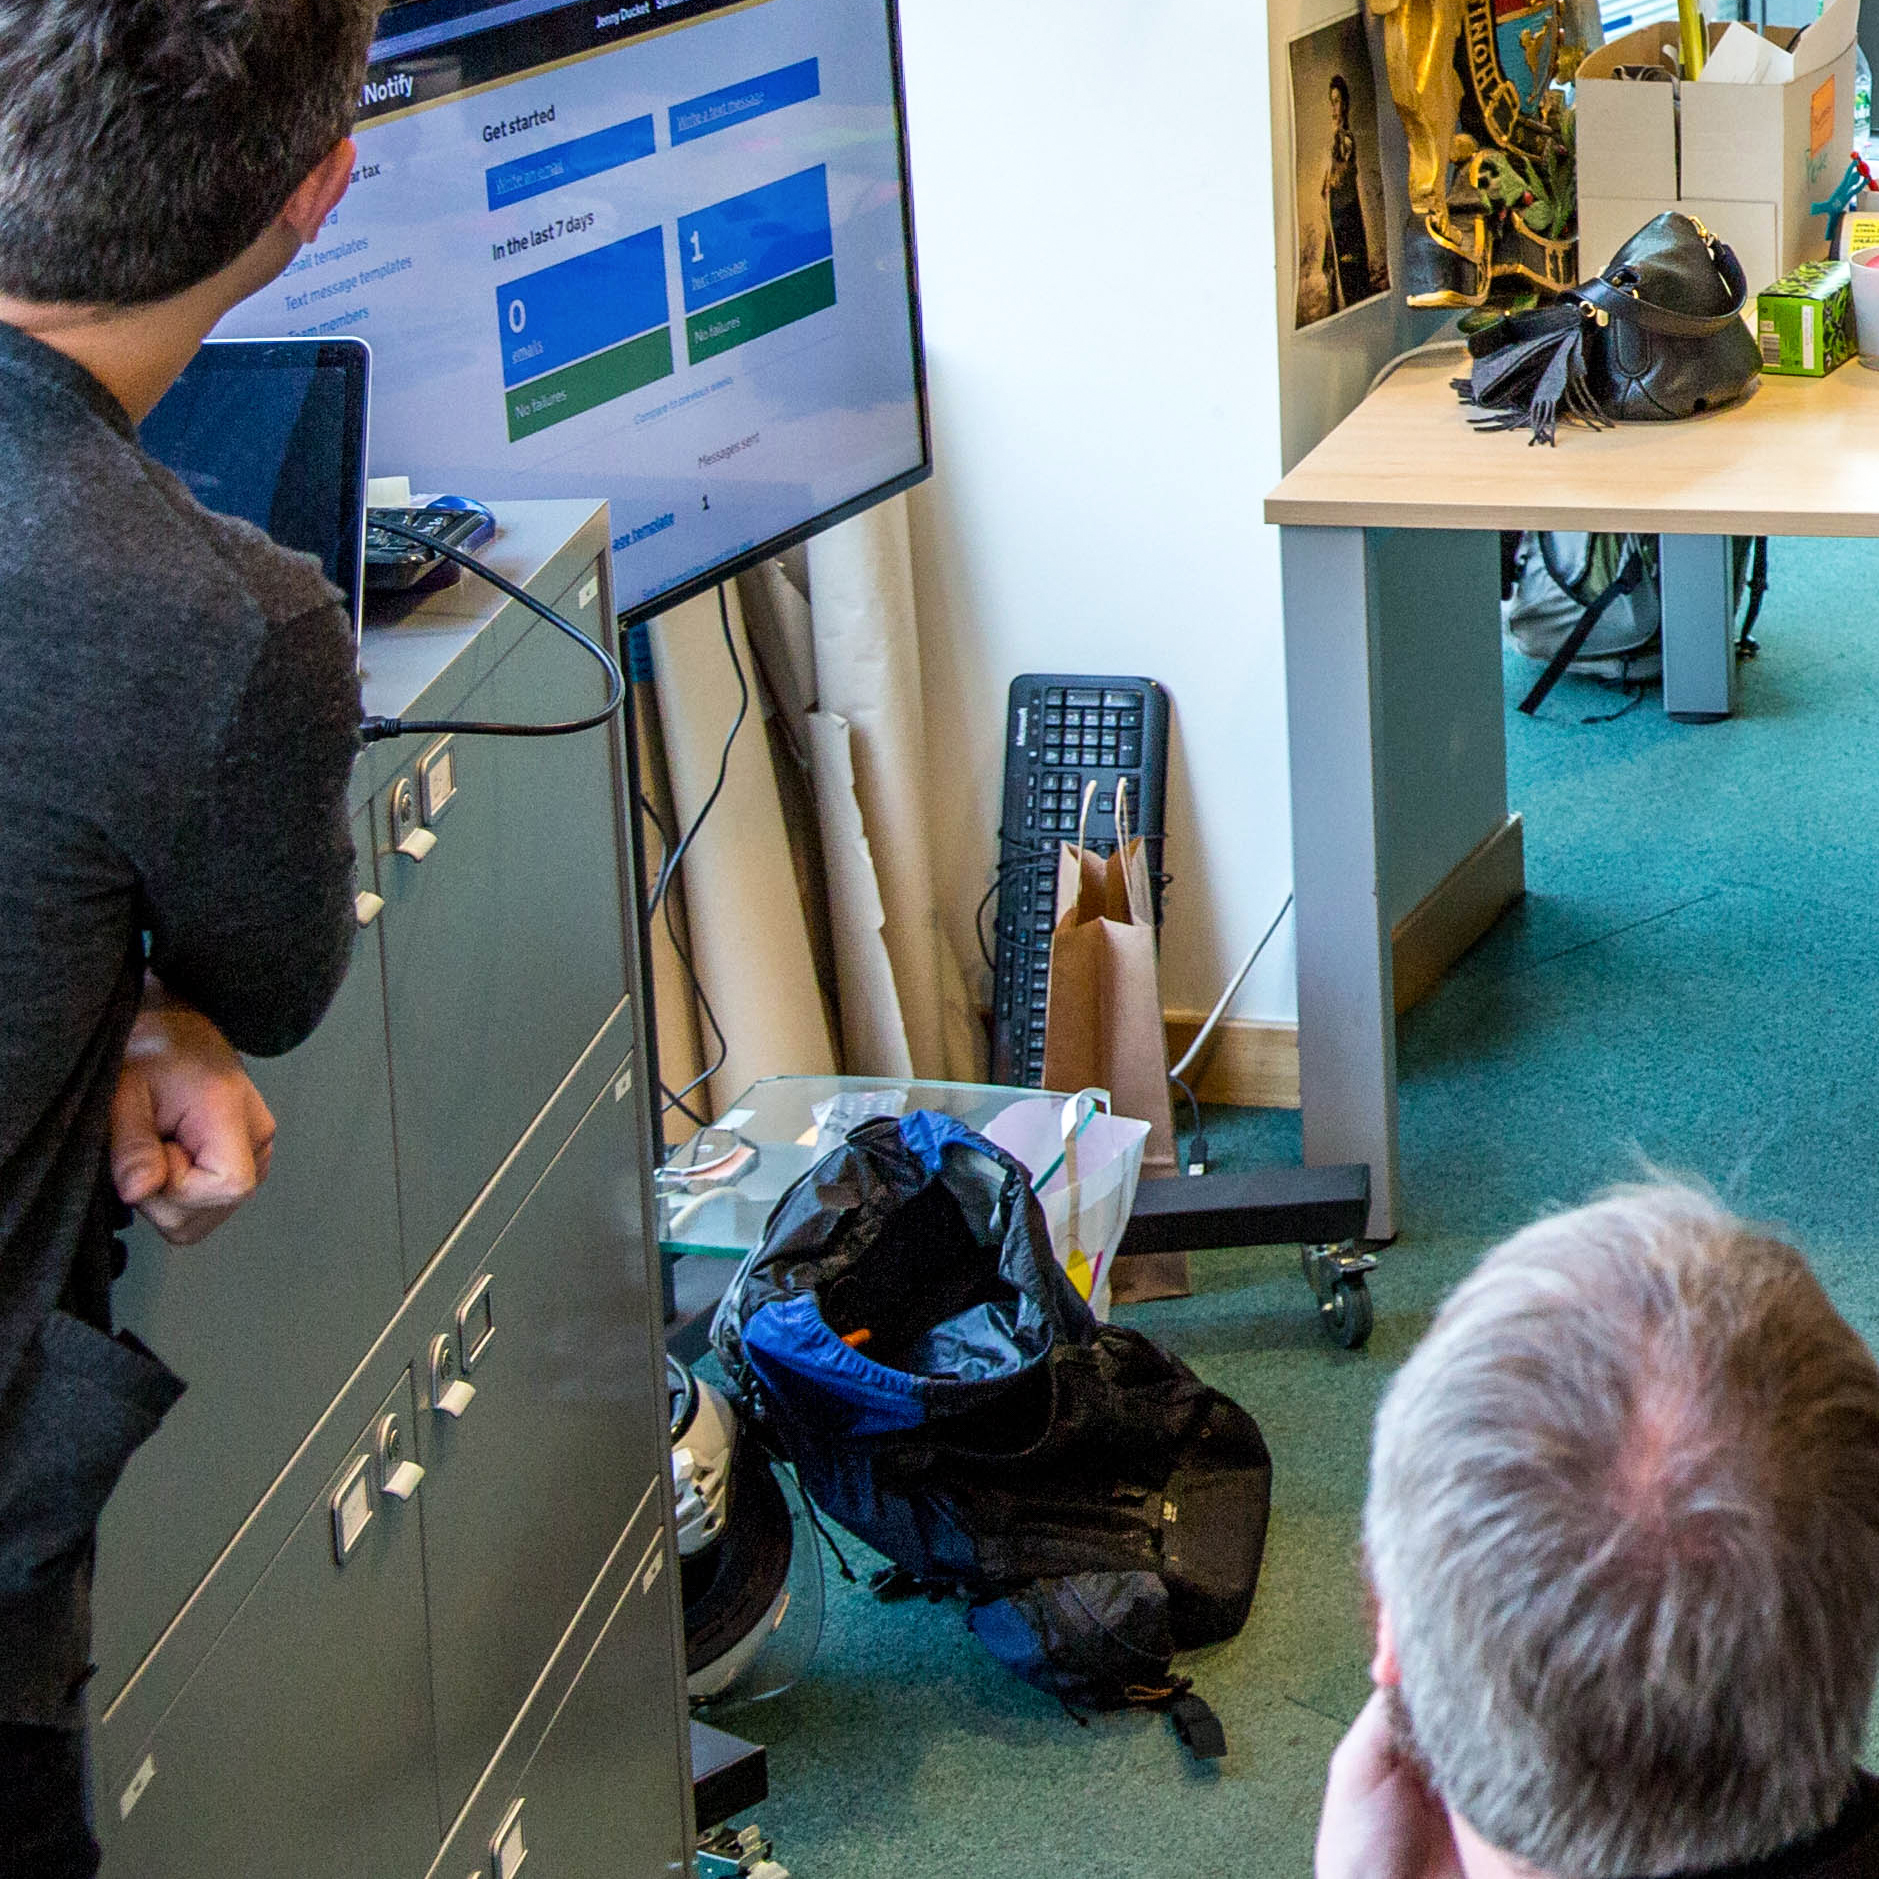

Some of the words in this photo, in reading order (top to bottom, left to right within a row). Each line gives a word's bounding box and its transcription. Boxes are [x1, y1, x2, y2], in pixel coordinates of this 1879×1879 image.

[363, 72, 414, 105] Notify
[482, 121, 508, 143] Get
[509, 104, 556, 134] started
[362, 163, 381, 180] tax
[493, 243, 506, 261] In
[507, 231, 529, 256] the
[530, 222, 554, 248] last
[554, 219, 565, 237] 7
[566, 209, 595, 234] days
[689, 229, 704, 263] 1
[314, 238, 369, 266] templates
[285, 292, 309, 311] Text
[311, 276, 358, 300] message
[359, 257, 413, 285] templates
[319, 307, 370, 335] members
[508, 298, 527, 334] 0
[694, 329, 709, 344] No
[709, 317, 741, 338] failures
[514, 404, 530, 419] No
[531, 389, 568, 413] failures
[702, 493, 710, 511] 1
